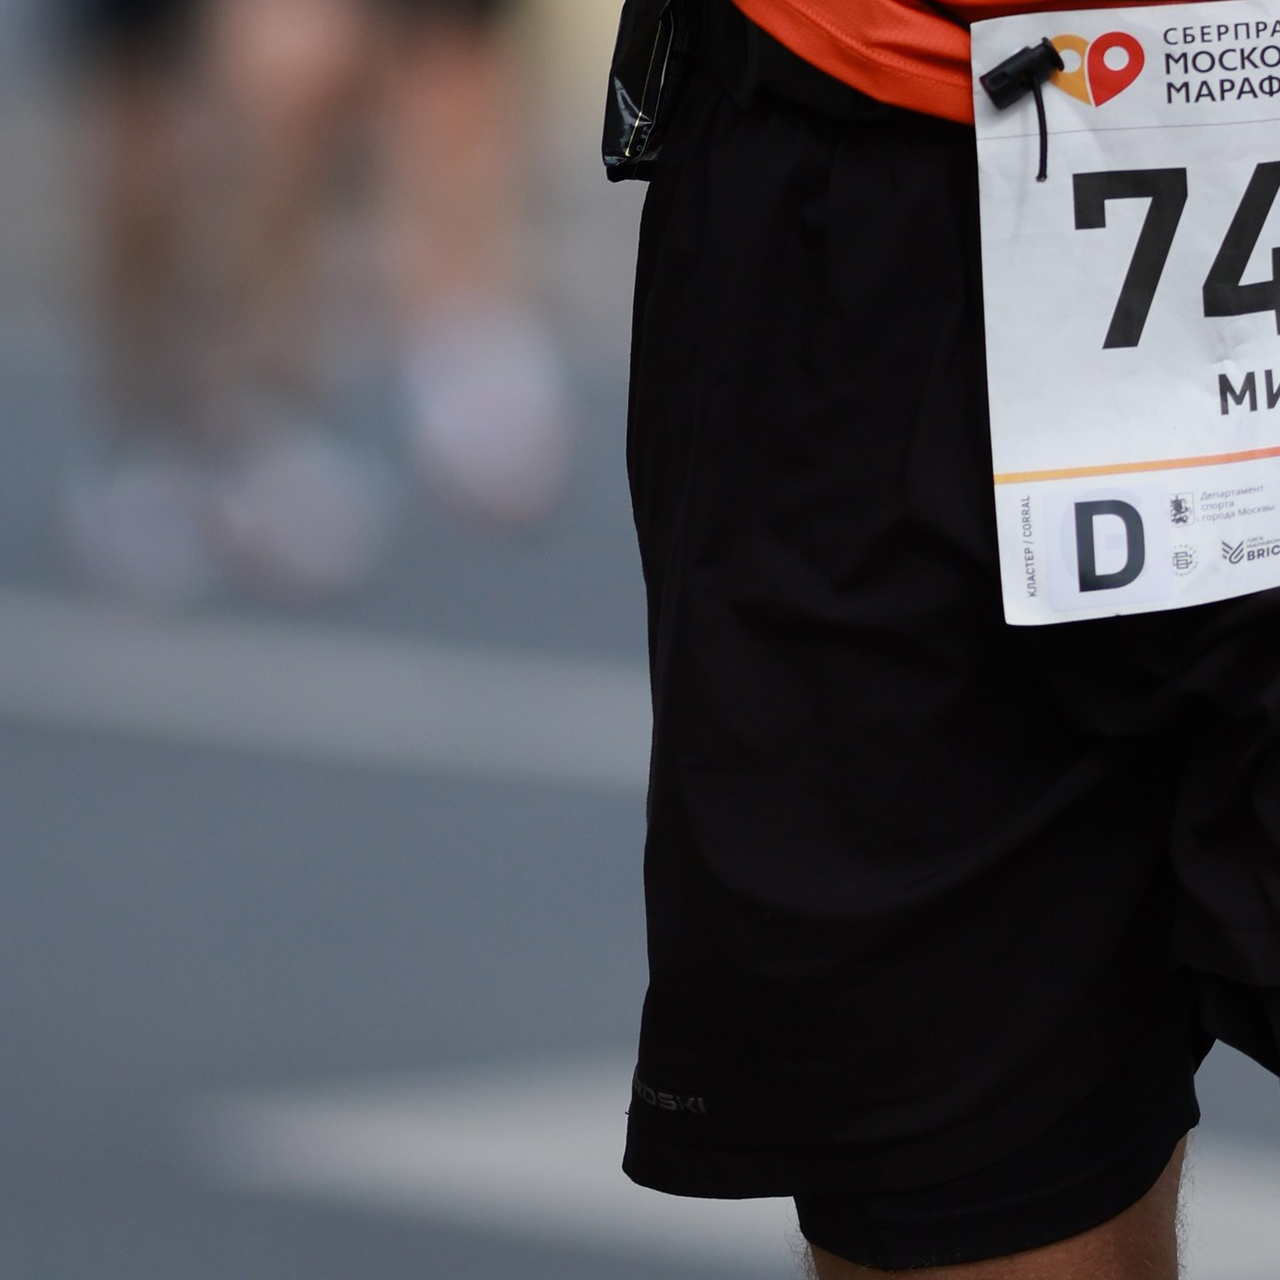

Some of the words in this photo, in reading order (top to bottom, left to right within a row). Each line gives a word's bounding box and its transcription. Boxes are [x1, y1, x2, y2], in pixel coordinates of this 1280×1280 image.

[1200, 485, 1264, 502] Департамент
[1201, 501, 1235, 512] спорта
[1020, 495, 1033, 538] CORRAL
[1201, 511, 1236, 523] города
[1237, 505, 1276, 519] Москвы
[1073, 499, 1146, 593] D
[1022, 547, 1037, 597] КЛАСТЕР
